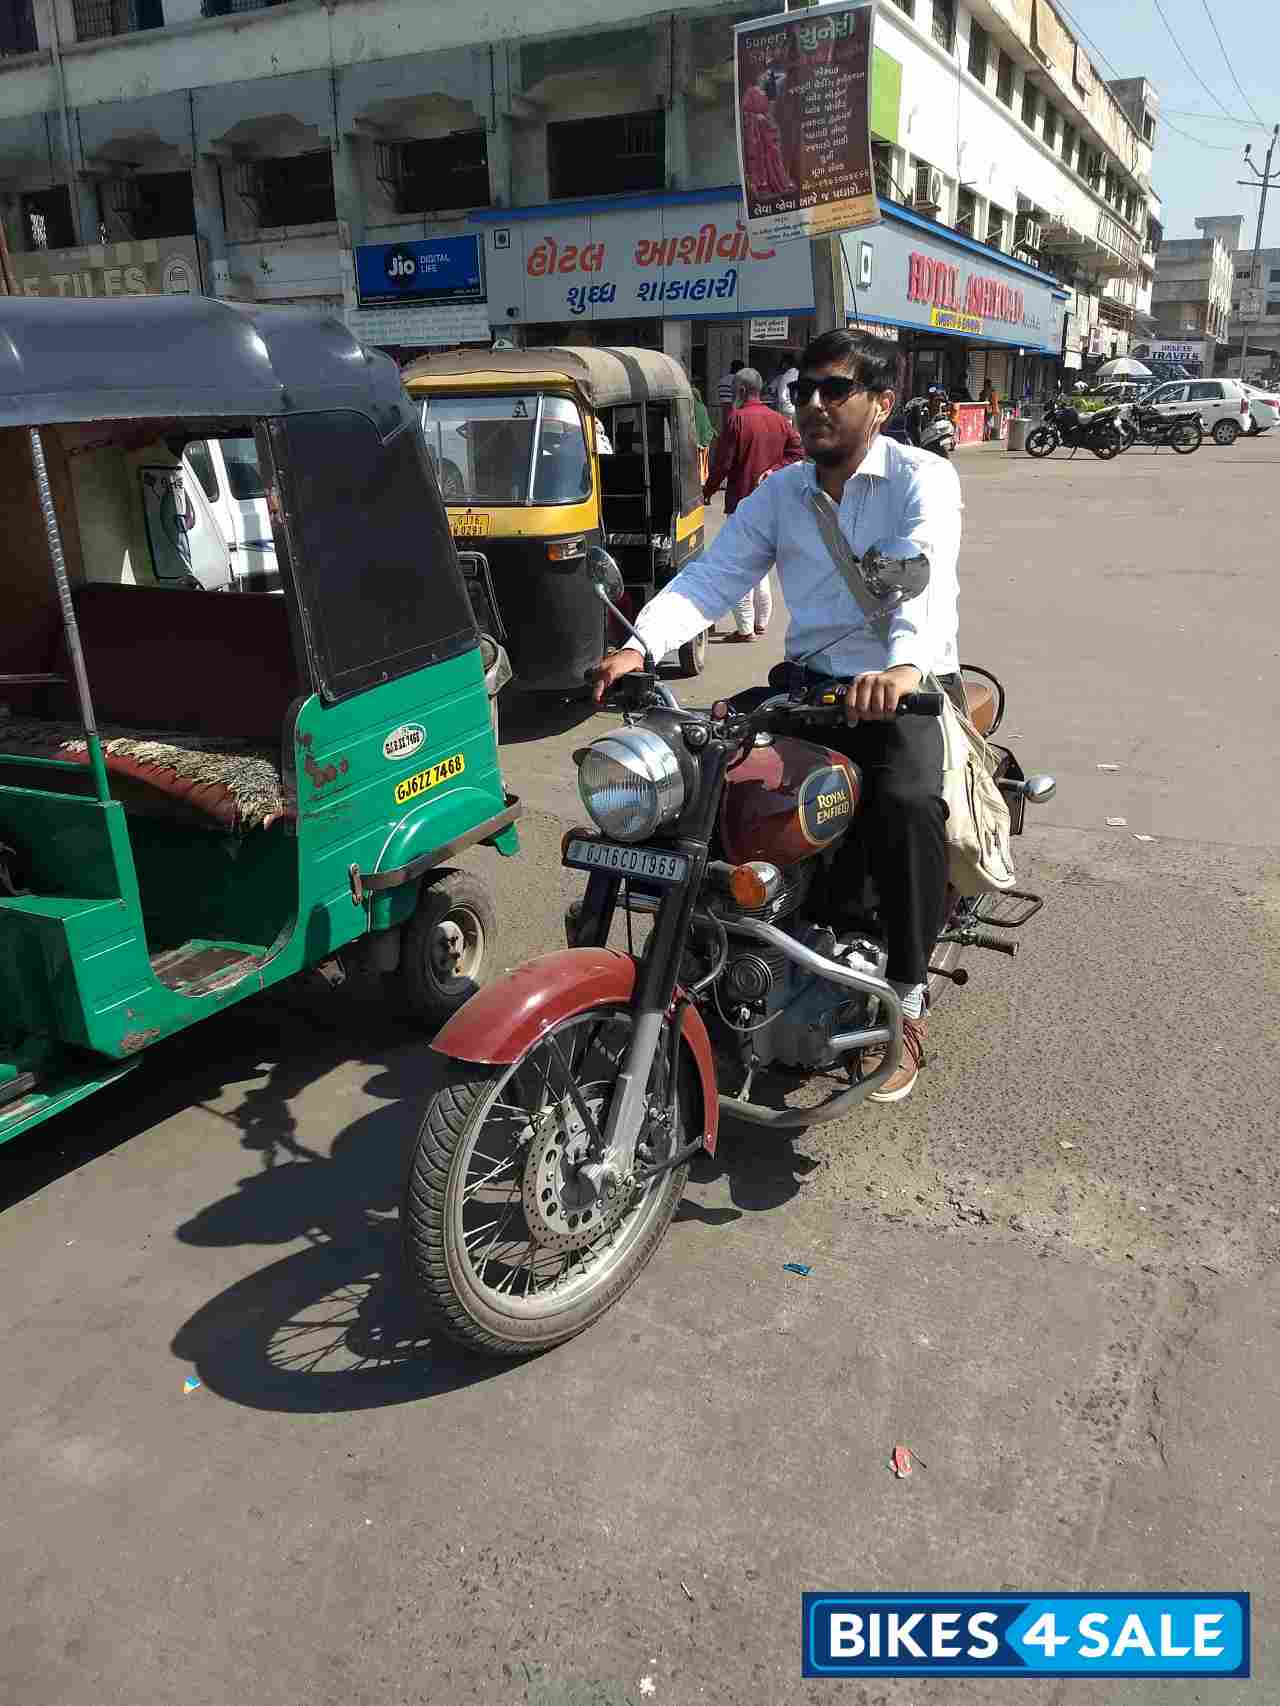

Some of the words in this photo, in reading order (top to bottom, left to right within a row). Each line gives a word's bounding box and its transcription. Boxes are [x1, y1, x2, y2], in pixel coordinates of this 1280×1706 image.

[388, 255, 416, 276] Jio
[419, 253, 451, 264] DIGITAL
[433, 755, 462, 782] 7468
[816, 791, 848, 807] ROYAL
[816, 802, 850, 825] ENFIELD
[586, 846, 677, 877] GJ16CD1969
